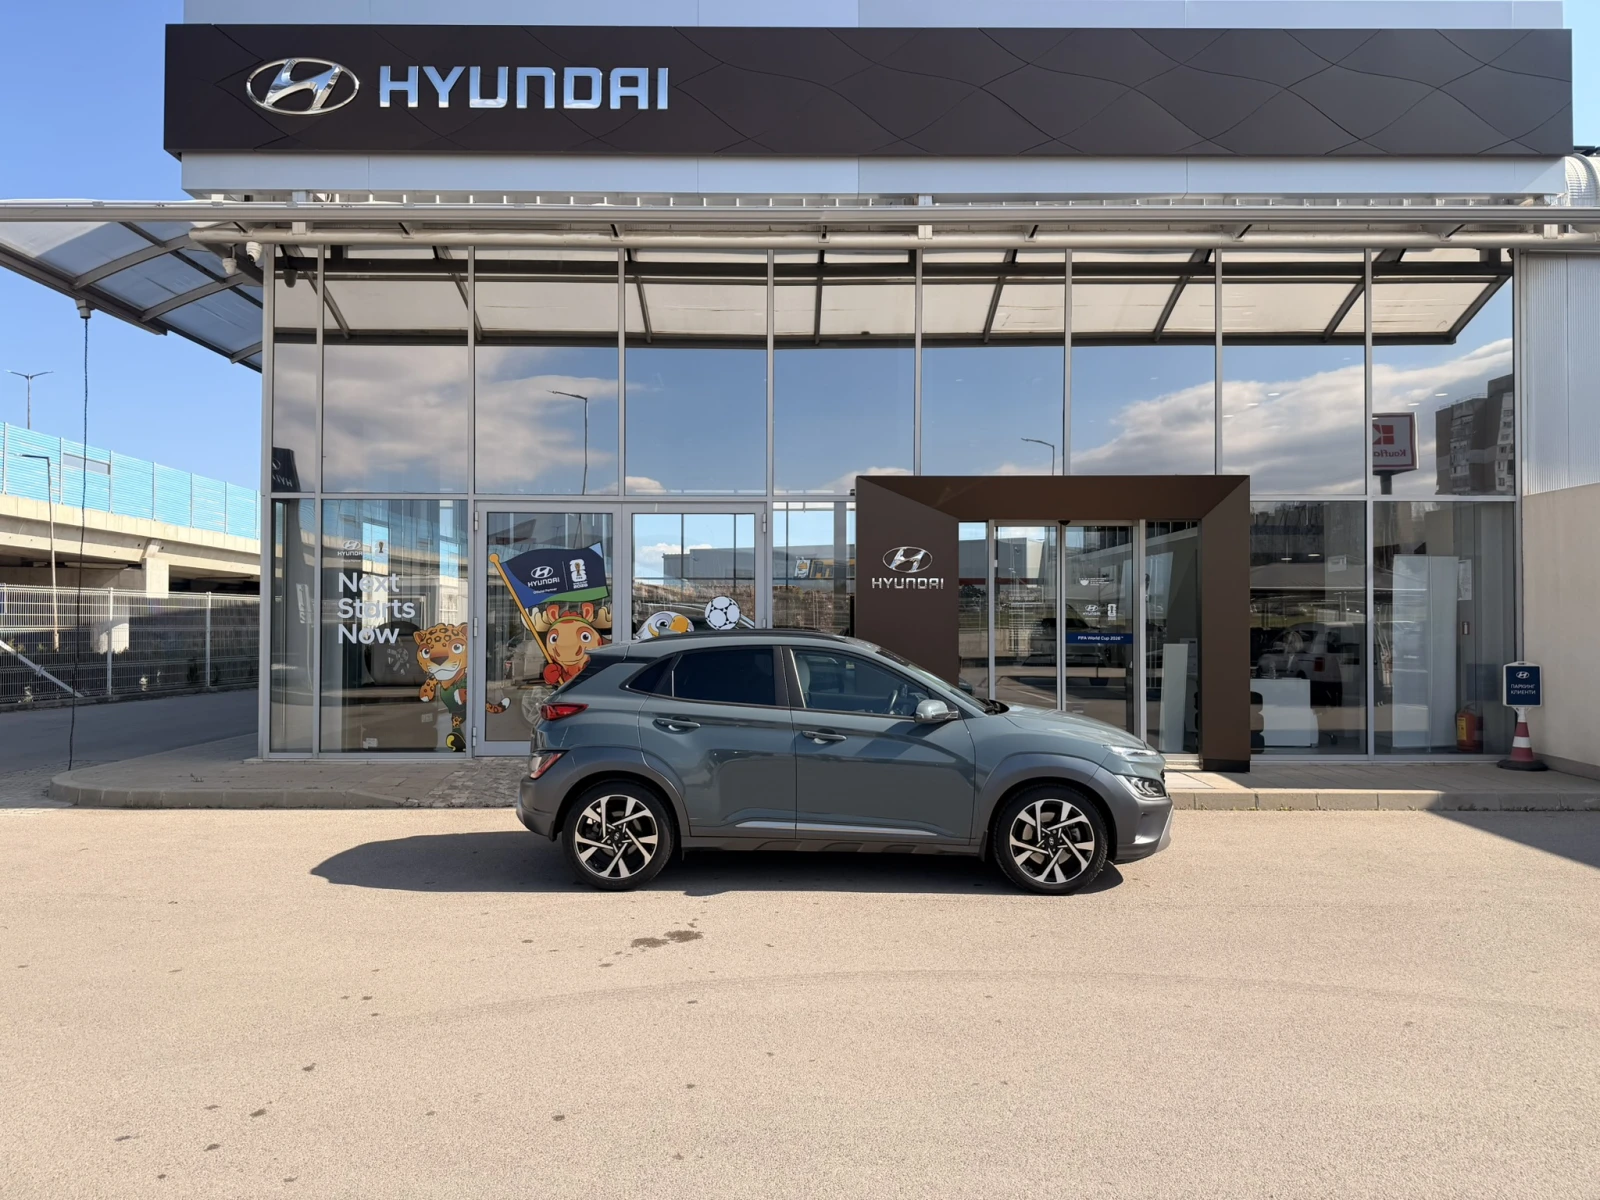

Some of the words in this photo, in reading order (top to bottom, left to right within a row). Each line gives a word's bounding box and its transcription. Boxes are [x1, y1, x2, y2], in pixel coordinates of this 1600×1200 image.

[379, 65, 669, 109] HYUNDAI
[338, 572, 400, 593] Next
[527, 577, 560, 587] HYUNDAI
[871, 577, 944, 590] HYUNDAI
[337, 597, 416, 619] Starts
[338, 623, 400, 644] Now
